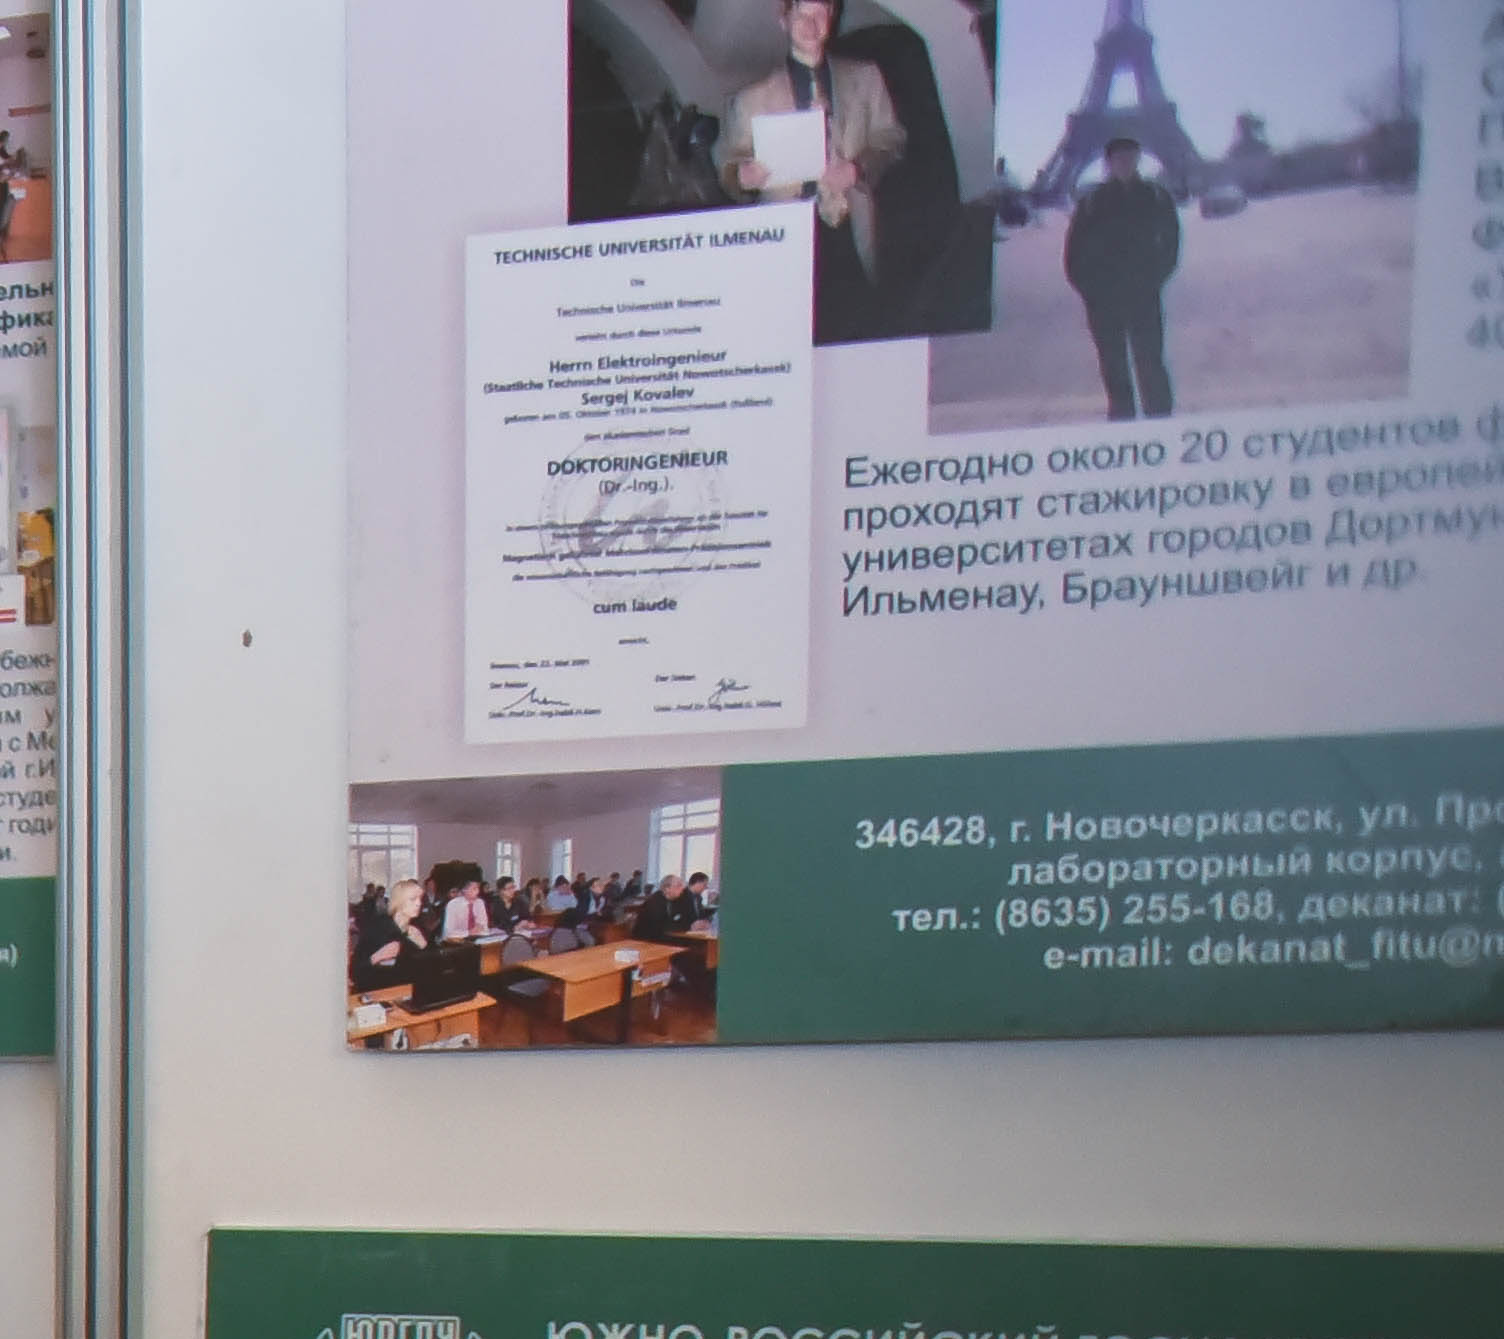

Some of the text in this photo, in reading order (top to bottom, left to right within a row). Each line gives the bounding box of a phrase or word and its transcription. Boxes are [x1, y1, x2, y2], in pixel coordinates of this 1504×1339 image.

[494, 228, 784, 264] TECHNISCHE UNIVERSITÄT ILMENAU
[547, 450, 727, 476] DOKTORINGENIEUR
[845, 452, 1033, 488] Ежегодно
[1047, 441, 1166, 473] около
[1180, 430, 1227, 463] 20
[845, 496, 1022, 537] проходят
[1038, 476, 1272, 519] стажировку
[1291, 475, 1311, 498] в
[842, 533, 1132, 583] университетах
[1148, 520, 1310, 558] городов
[593, 597, 677, 613] cum laude
[843, 582, 1044, 617] Ильменау,
[1062, 564, 1303, 610] Брауншвейг
[1327, 564, 1348, 585] и
[855, 814, 995, 849] 346428,
[1010, 821, 1033, 844] г.
[1046, 809, 1341, 842] Новочеркасск,
[1358, 802, 1418, 836] ул.
[1007, 847, 1481, 889] лабораторный корпус,
[891, 907, 980, 931] тел.:
[995, 895, 1109, 935] (8635)
[1123, 889, 1283, 924] 255-168,
[1043, 936, 1172, 969] e-mail:
